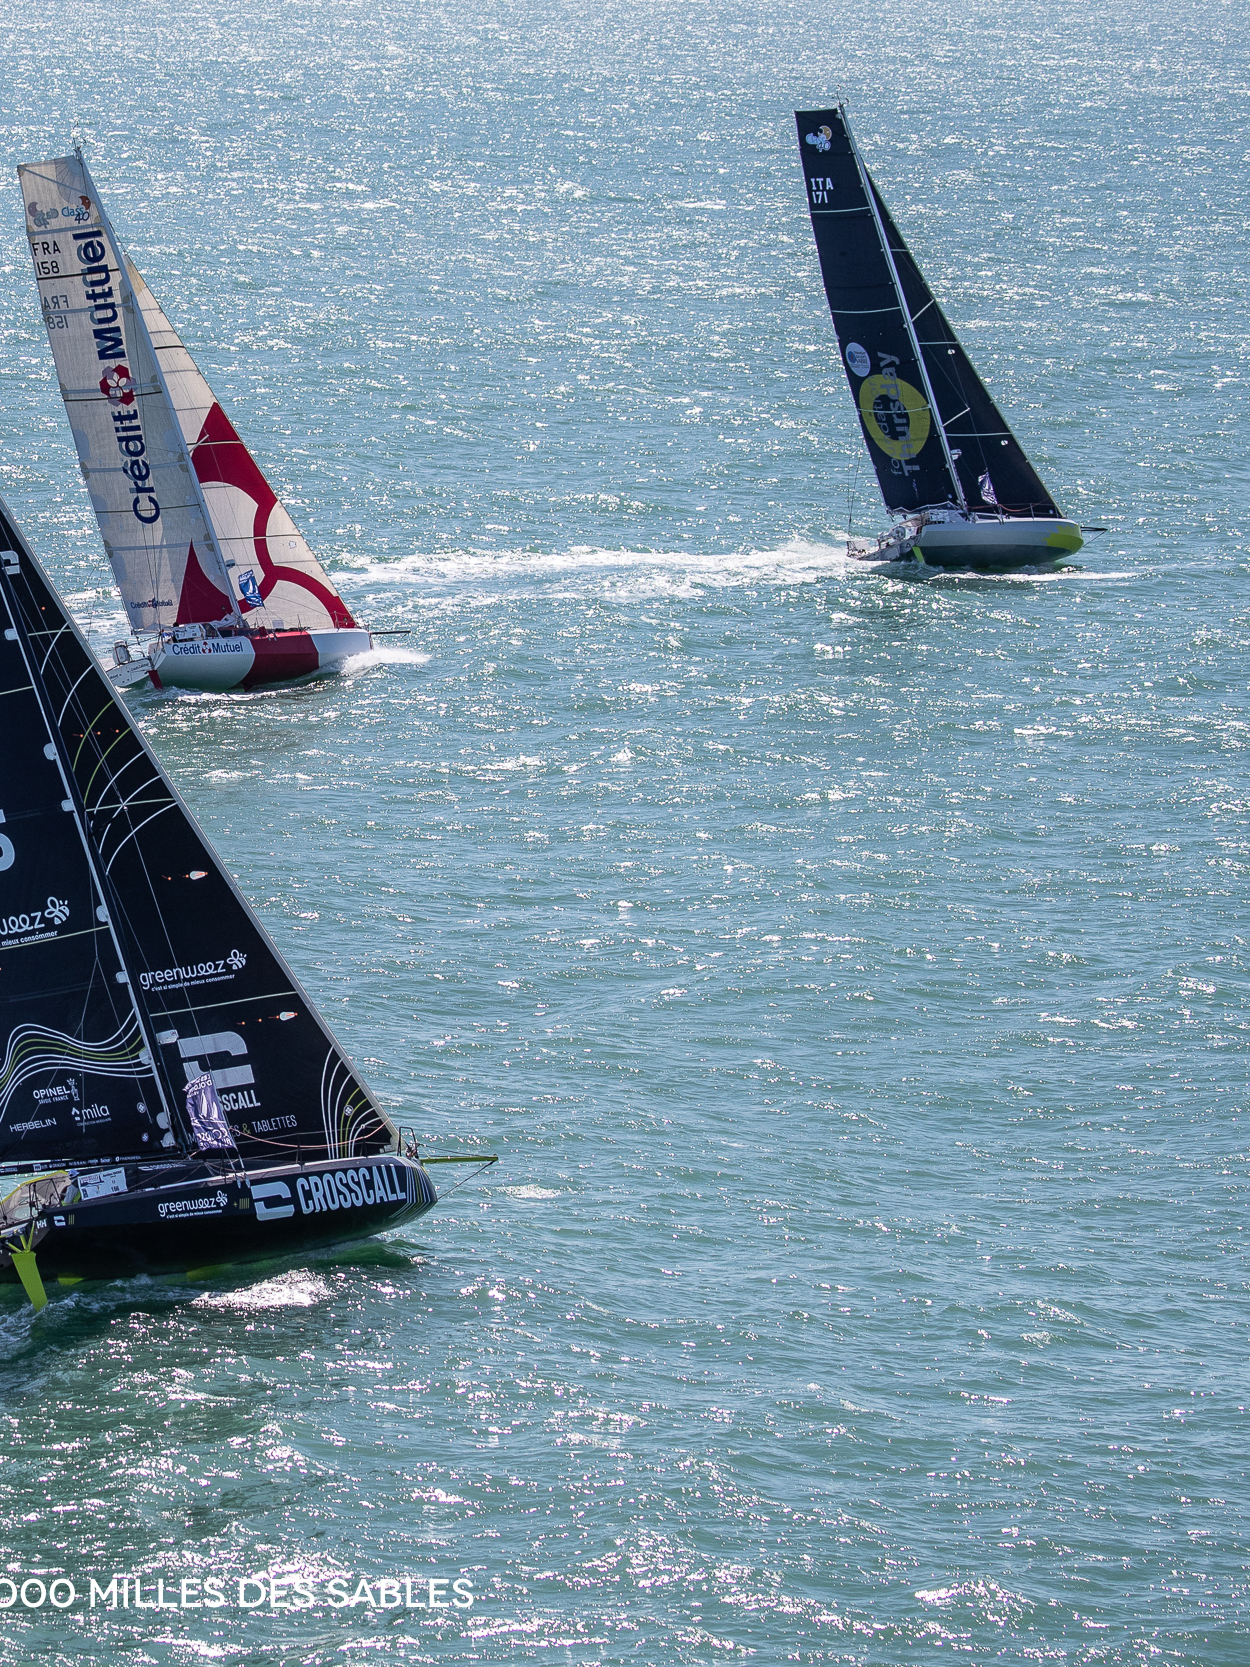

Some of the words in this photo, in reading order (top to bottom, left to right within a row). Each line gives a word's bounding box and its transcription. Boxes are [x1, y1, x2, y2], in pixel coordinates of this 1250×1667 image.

[810, 177, 834, 190] ITA
[811, 191, 829, 204] 171
[61, 205, 85, 217] Class
[74, 210, 90, 224] 40
[31, 240, 61, 257] FRA
[36, 260, 60, 276] 158
[72, 229, 127, 360] Mutuel
[877, 351, 921, 477] Thursday
[111, 408, 161, 524] Crédit
[172, 642, 202, 655] Crédit
[211, 641, 243, 654] Mutuel
[139, 960, 226, 990] greenweez
[33, 1085, 71, 1099] OPINEL
[81, 1103, 110, 1120] mila
[10, 1117, 57, 1132] HERBELIN
[252, 1114, 298, 1133] TABLETTES
[296, 1164, 406, 1215] CROSSCALL
[158, 1198, 217, 1217] greenweez
